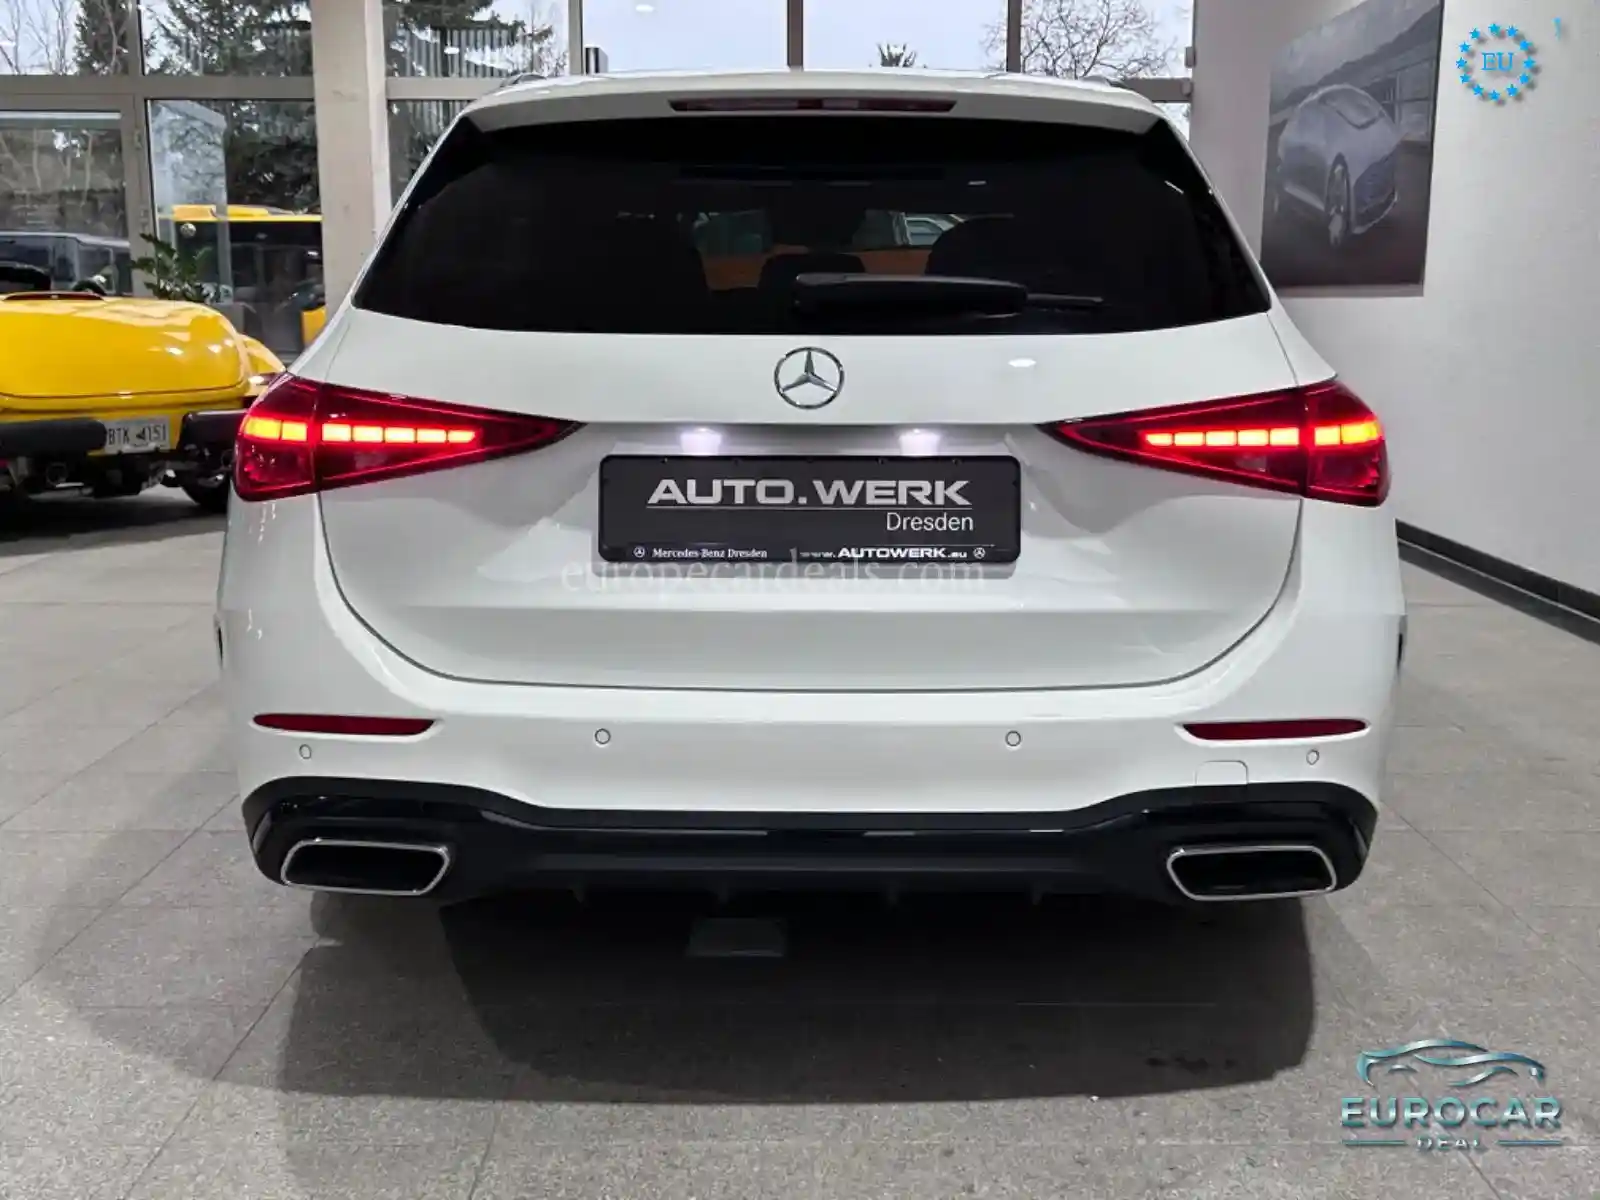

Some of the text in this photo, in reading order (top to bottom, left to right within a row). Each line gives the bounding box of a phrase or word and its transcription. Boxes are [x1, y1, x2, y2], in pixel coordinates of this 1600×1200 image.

[647, 478, 973, 506] AUTO.WERK
[885, 511, 974, 532] Dresden
[727, 547, 768, 558] Dresden
